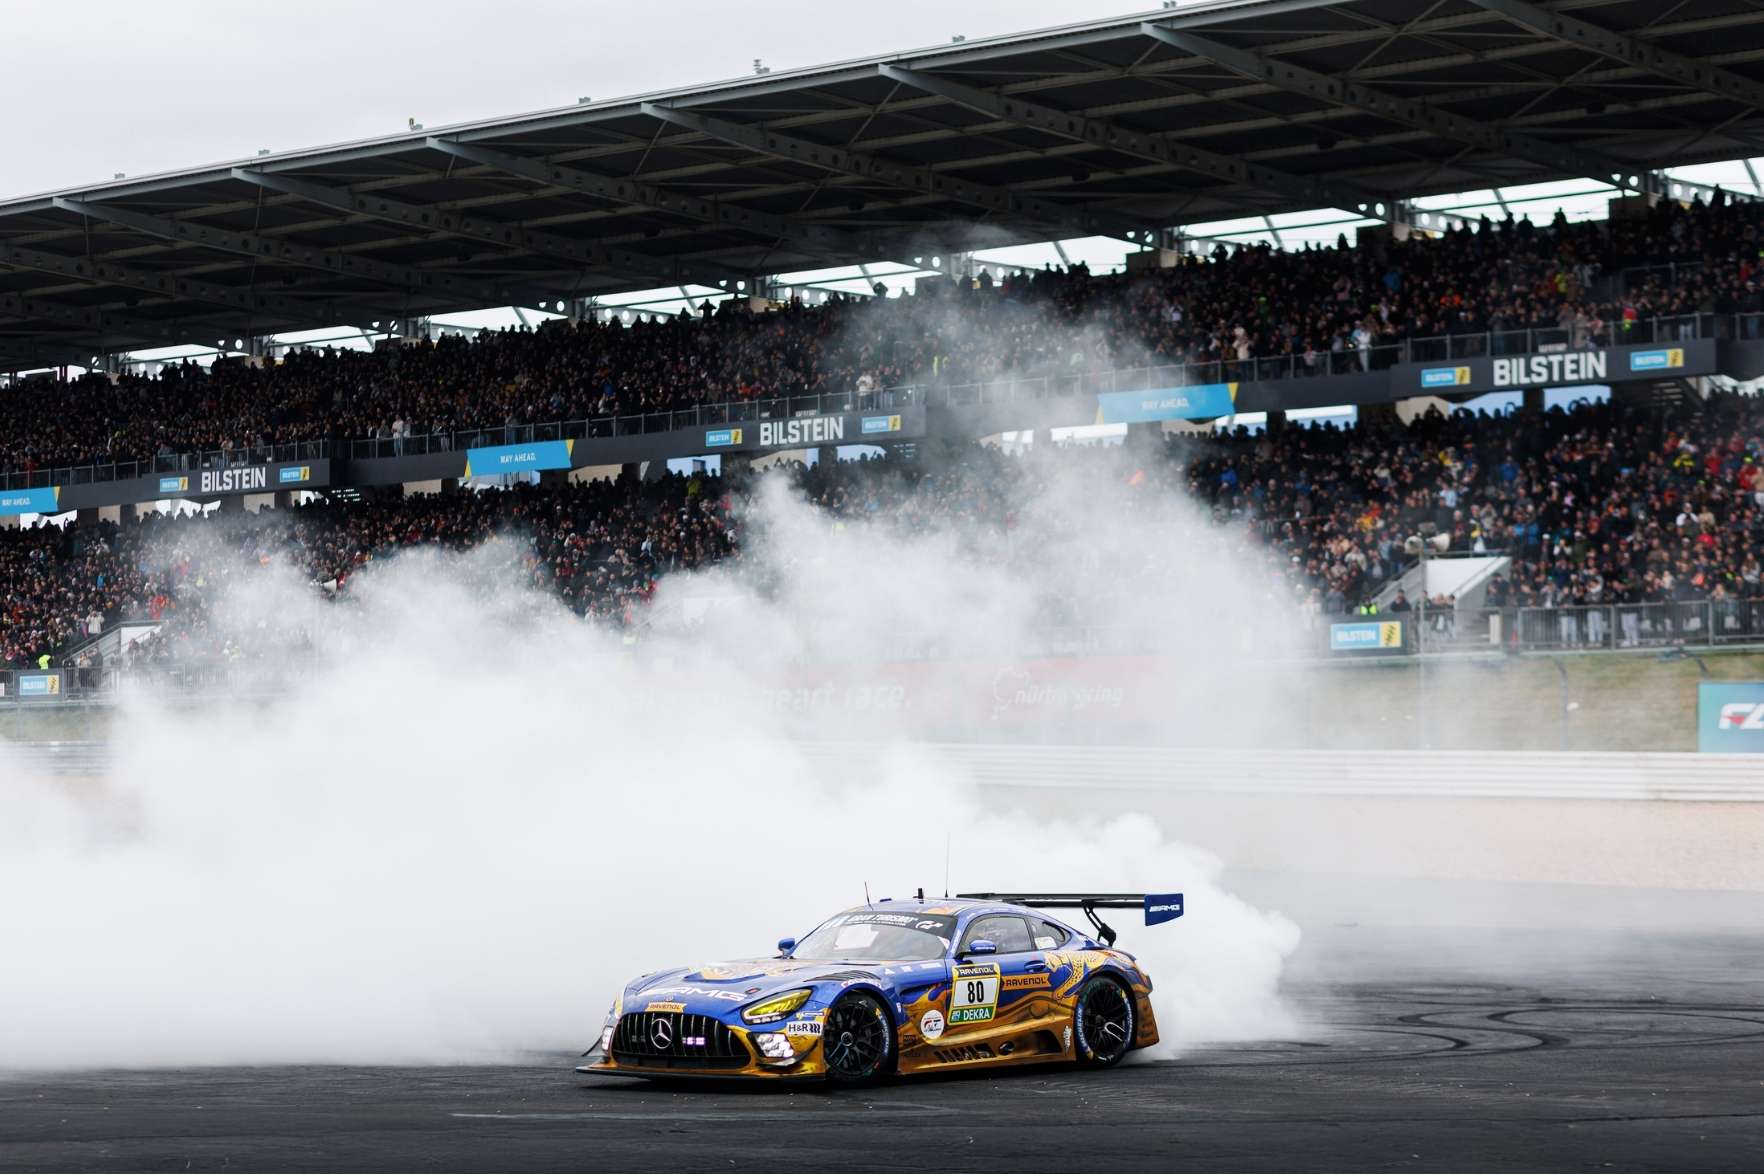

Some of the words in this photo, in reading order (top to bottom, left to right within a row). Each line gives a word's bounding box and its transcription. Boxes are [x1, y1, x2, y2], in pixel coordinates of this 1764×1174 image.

[1493, 351, 1607, 386] BILSTEIN
[760, 416, 844, 446] BILSTEIN
[201, 467, 266, 492] BILSTEIN
[959, 967, 994, 976] RAVENOL
[1006, 976, 1047, 987] RAVENOL
[967, 980, 985, 1004] 80
[963, 1008, 991, 1020] DEKRA
[788, 1023, 809, 1032] H&R
